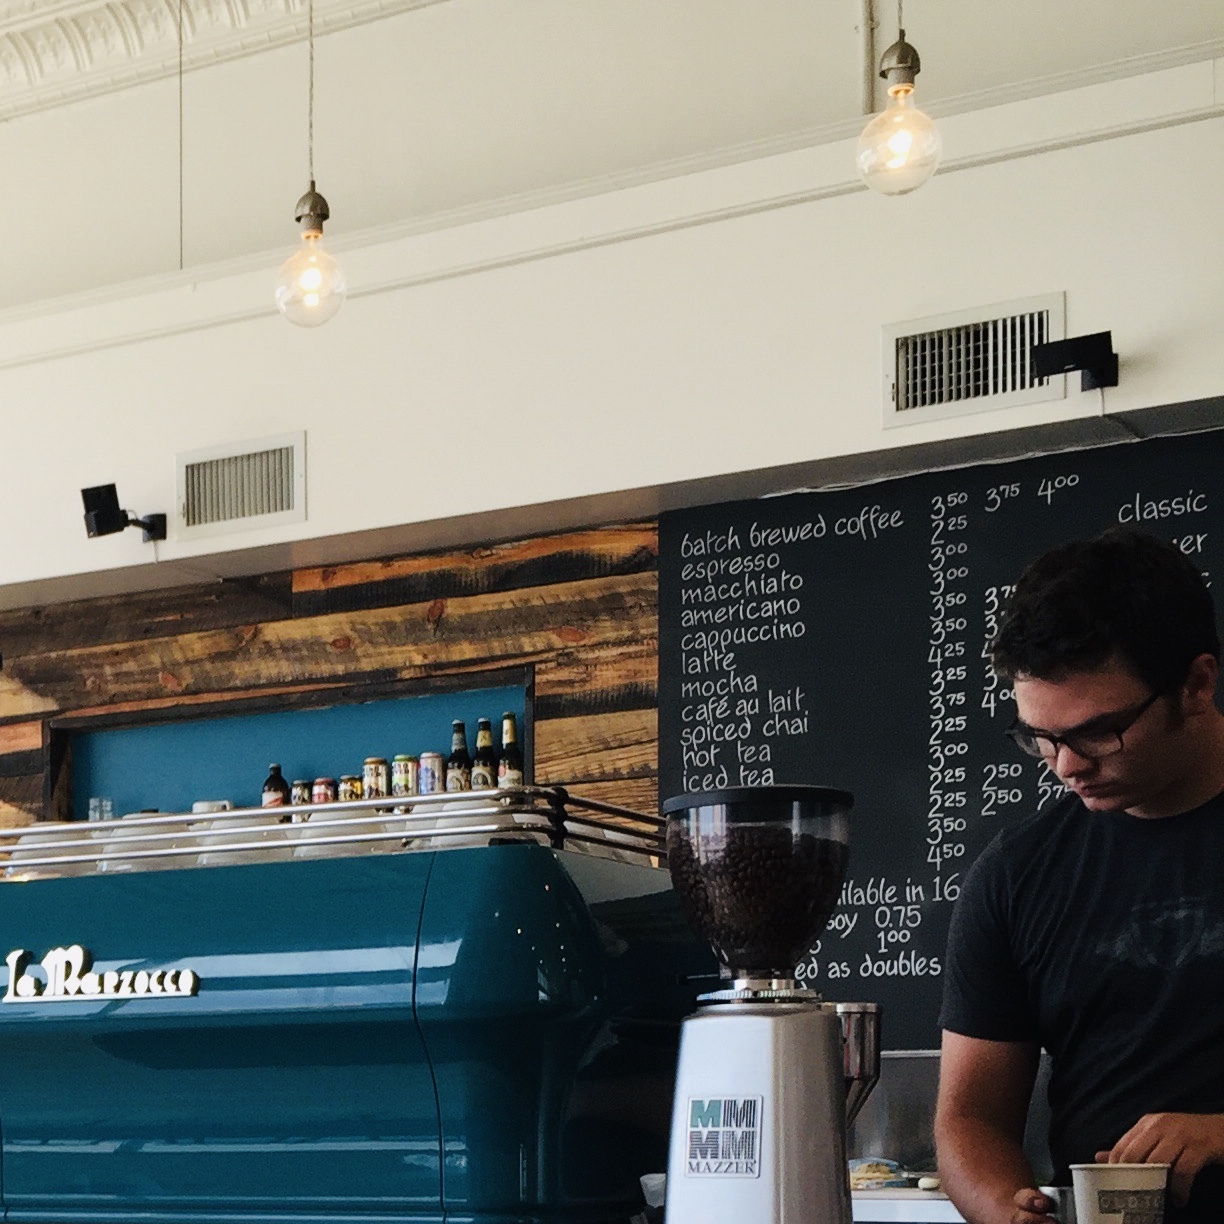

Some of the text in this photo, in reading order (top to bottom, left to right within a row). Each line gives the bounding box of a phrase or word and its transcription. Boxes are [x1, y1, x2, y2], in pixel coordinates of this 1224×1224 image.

[1118, 489, 1208, 523] classic
[681, 526, 740, 558] batch
[750, 514, 826, 547] brewed
[835, 505, 904, 540] coffee
[1172, 533, 1208, 555] er
[681, 553, 780, 583] espresso
[681, 570, 803, 605] macchiato
[681, 598, 800, 627] americano
[681, 619, 806, 656] cappuccino
[682, 650, 737, 674] latte
[682, 670, 758, 698] mocha
[681, 696, 731, 726] café
[736, 698, 759, 716] au
[768, 687, 805, 713] lait
[680, 716, 751, 750] spiced
[763, 710, 808, 737] chai
[683, 744, 721, 769] hot
[738, 740, 771, 763] tea
[683, 765, 728, 792] iced
[740, 765, 774, 786] tea
[837, 873, 960, 906] ilable in 16
[875, 905, 922, 928] 0.75
[41, 944, 195, 998] Marzocco
[828, 961, 851, 979] as
[859, 950, 942, 977] doubles
[687, 1161, 757, 1174] MAZZER
